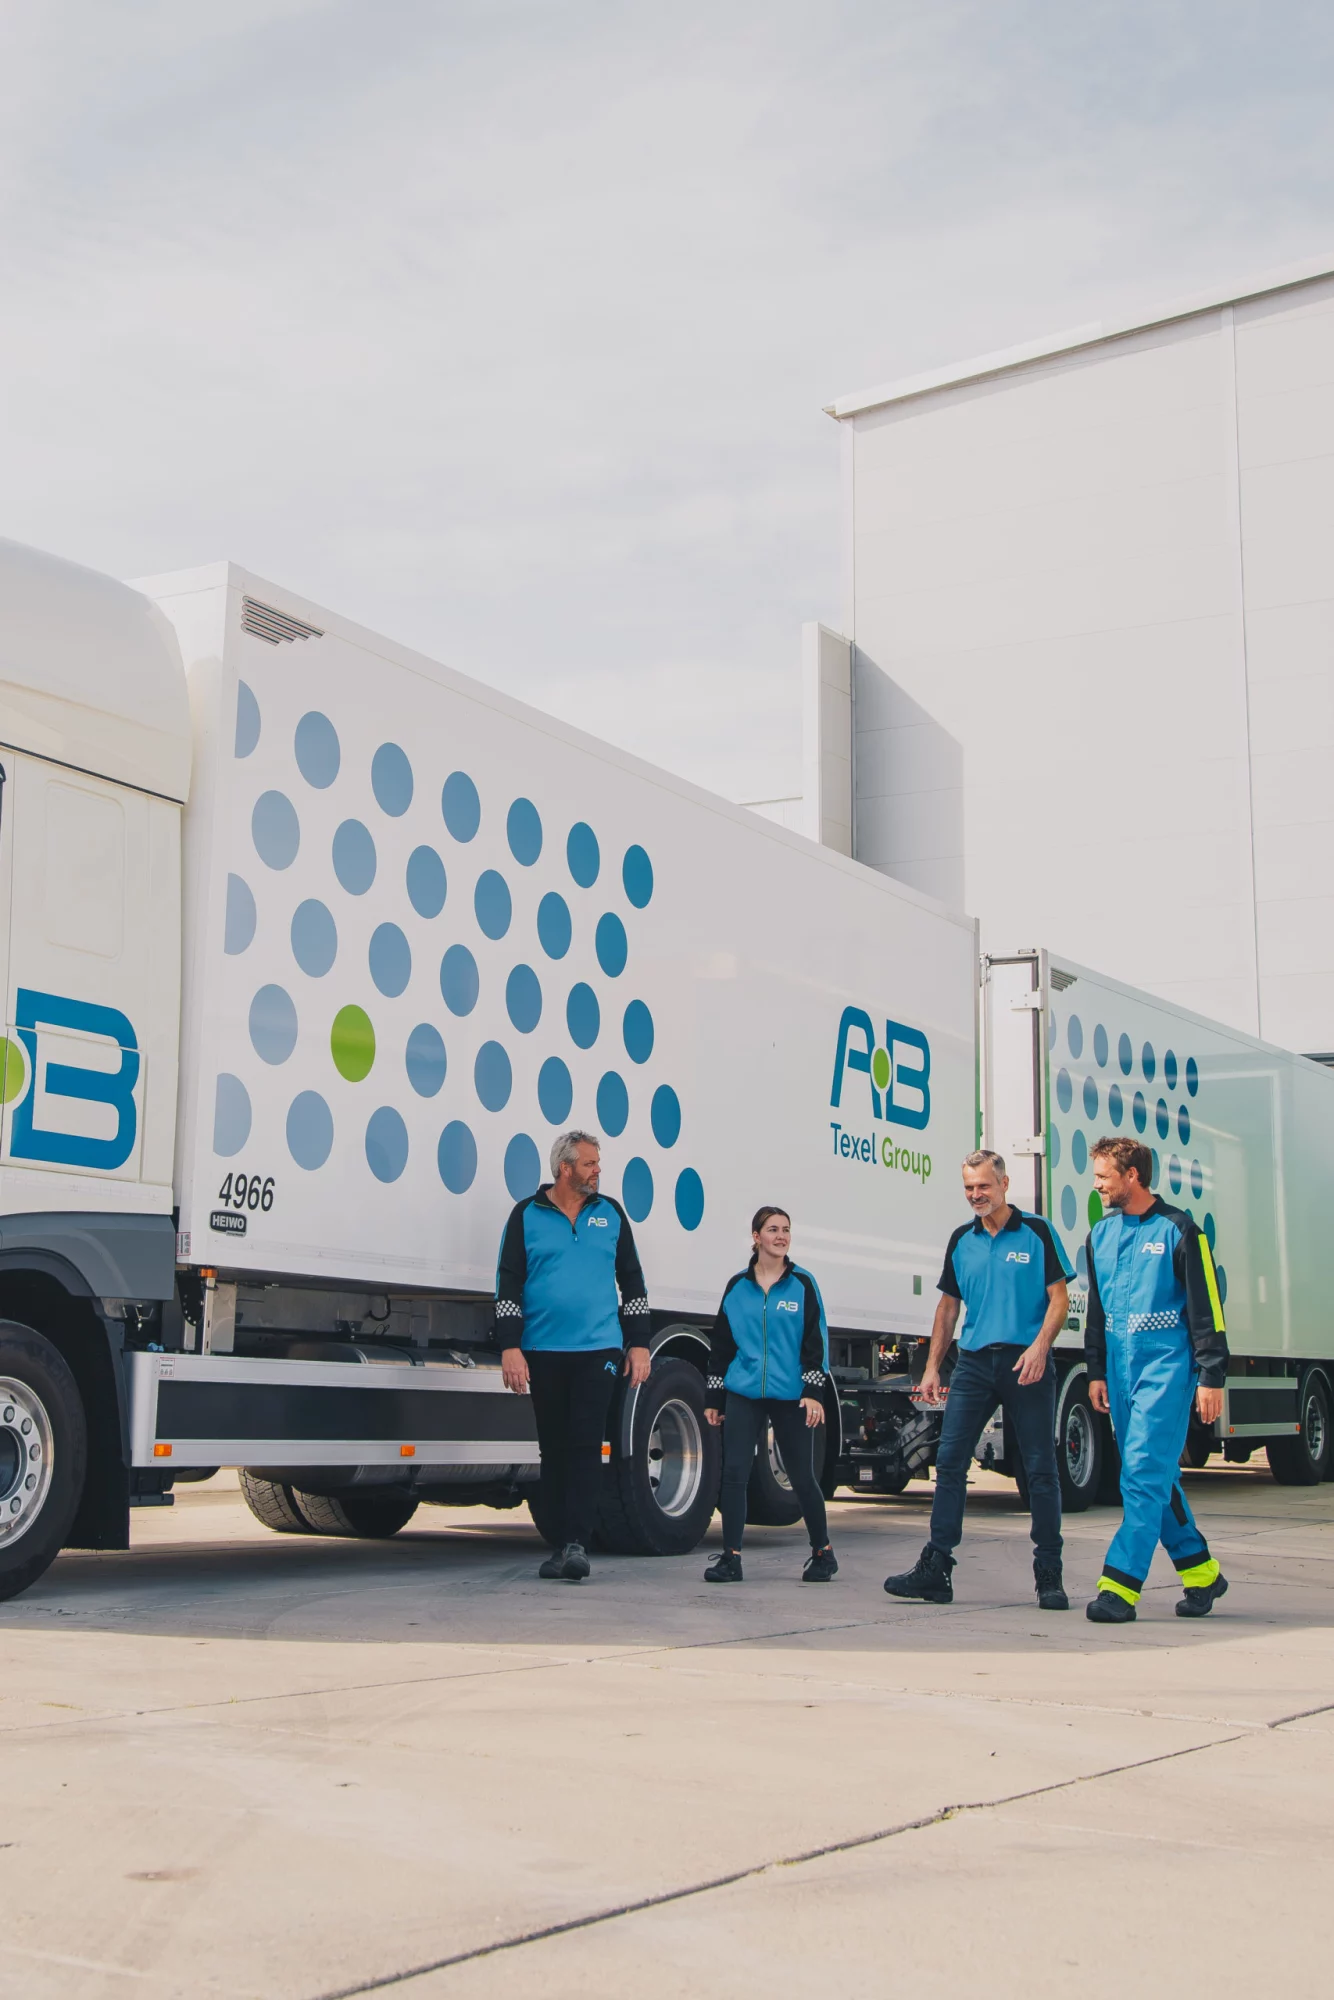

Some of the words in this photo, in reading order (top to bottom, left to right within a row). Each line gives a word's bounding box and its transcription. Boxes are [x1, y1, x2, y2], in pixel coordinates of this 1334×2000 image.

[829, 1005, 931, 1131] AB
[830, 1122, 877, 1165] Texel
[881, 1136, 932, 1184] Group
[219, 1172, 275, 1212] 4966
[212, 1214, 245, 1230] HEIWO
[587, 1216, 608, 1227] AB
[1141, 1242, 1165, 1255] AB
[1005, 1252, 1030, 1264] AB
[776, 1300, 799, 1312] AB
